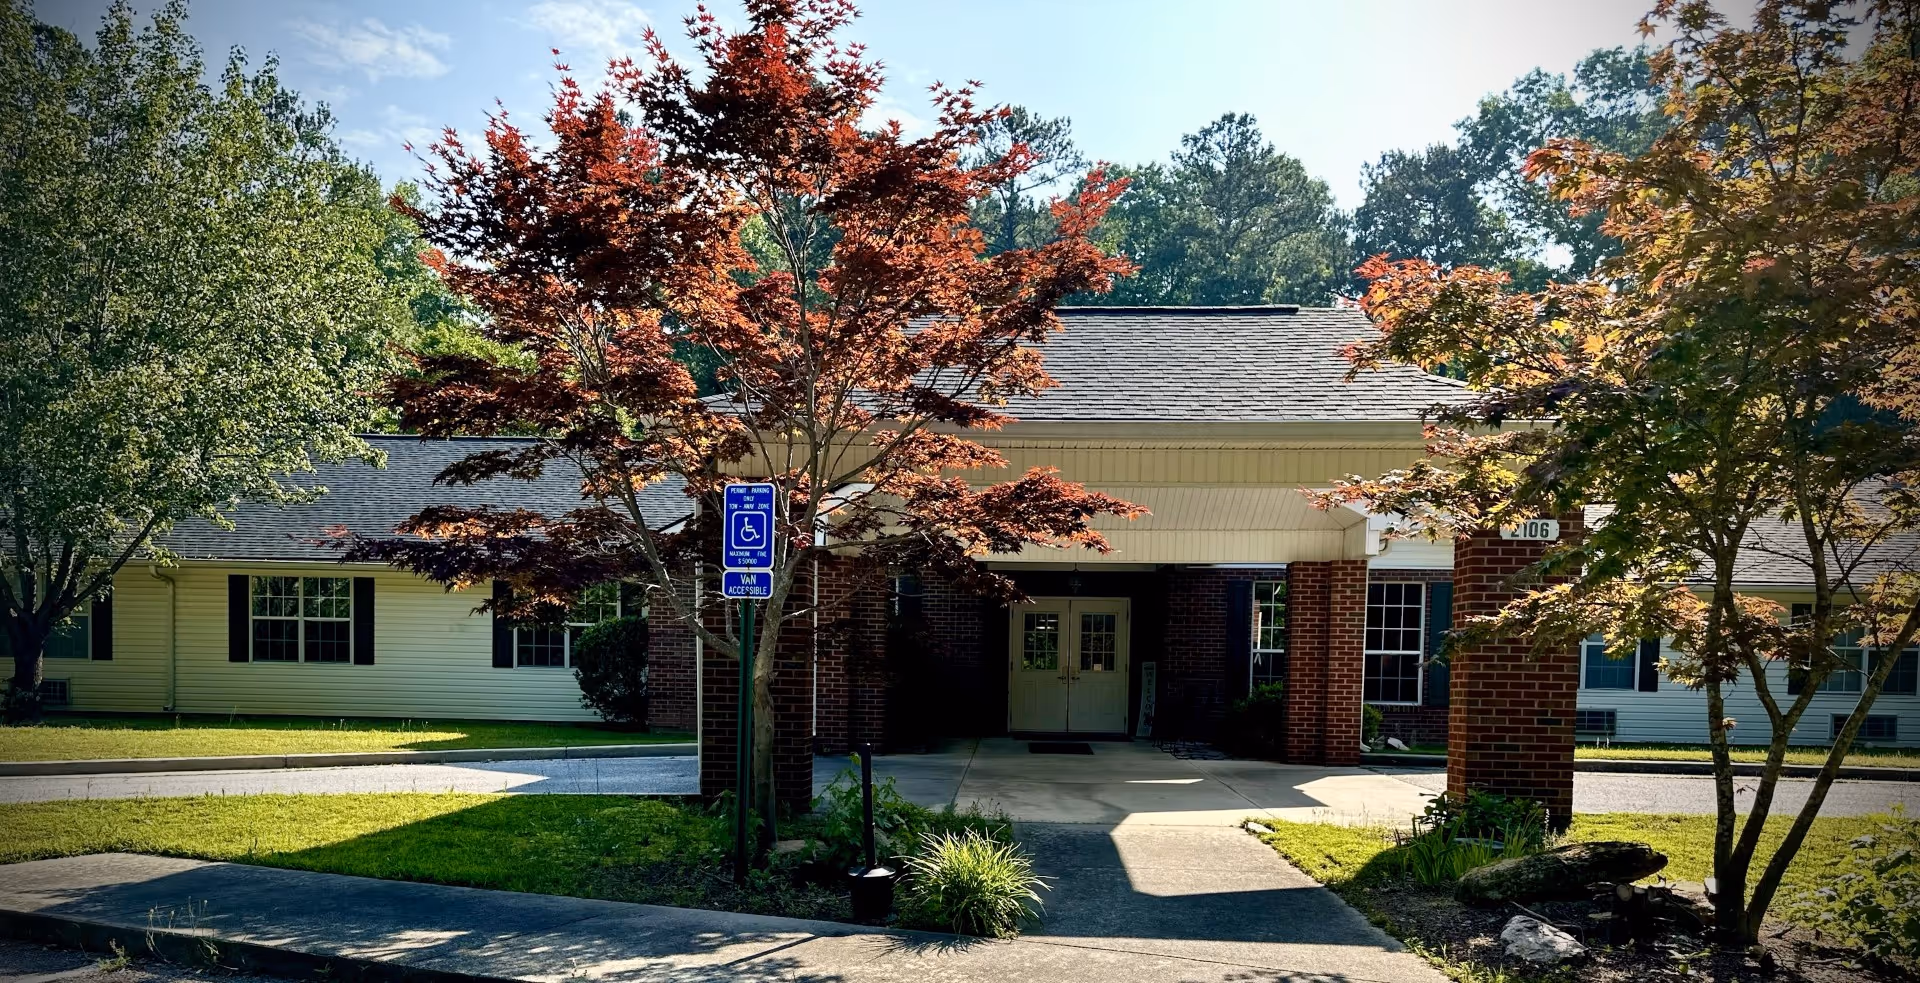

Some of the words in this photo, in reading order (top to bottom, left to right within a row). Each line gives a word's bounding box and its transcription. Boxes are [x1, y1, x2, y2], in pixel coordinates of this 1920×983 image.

[1510, 521, 1550, 538] 2106
[740, 574, 757, 585] VAN
[728, 586, 767, 595] ACCESSIBLE
